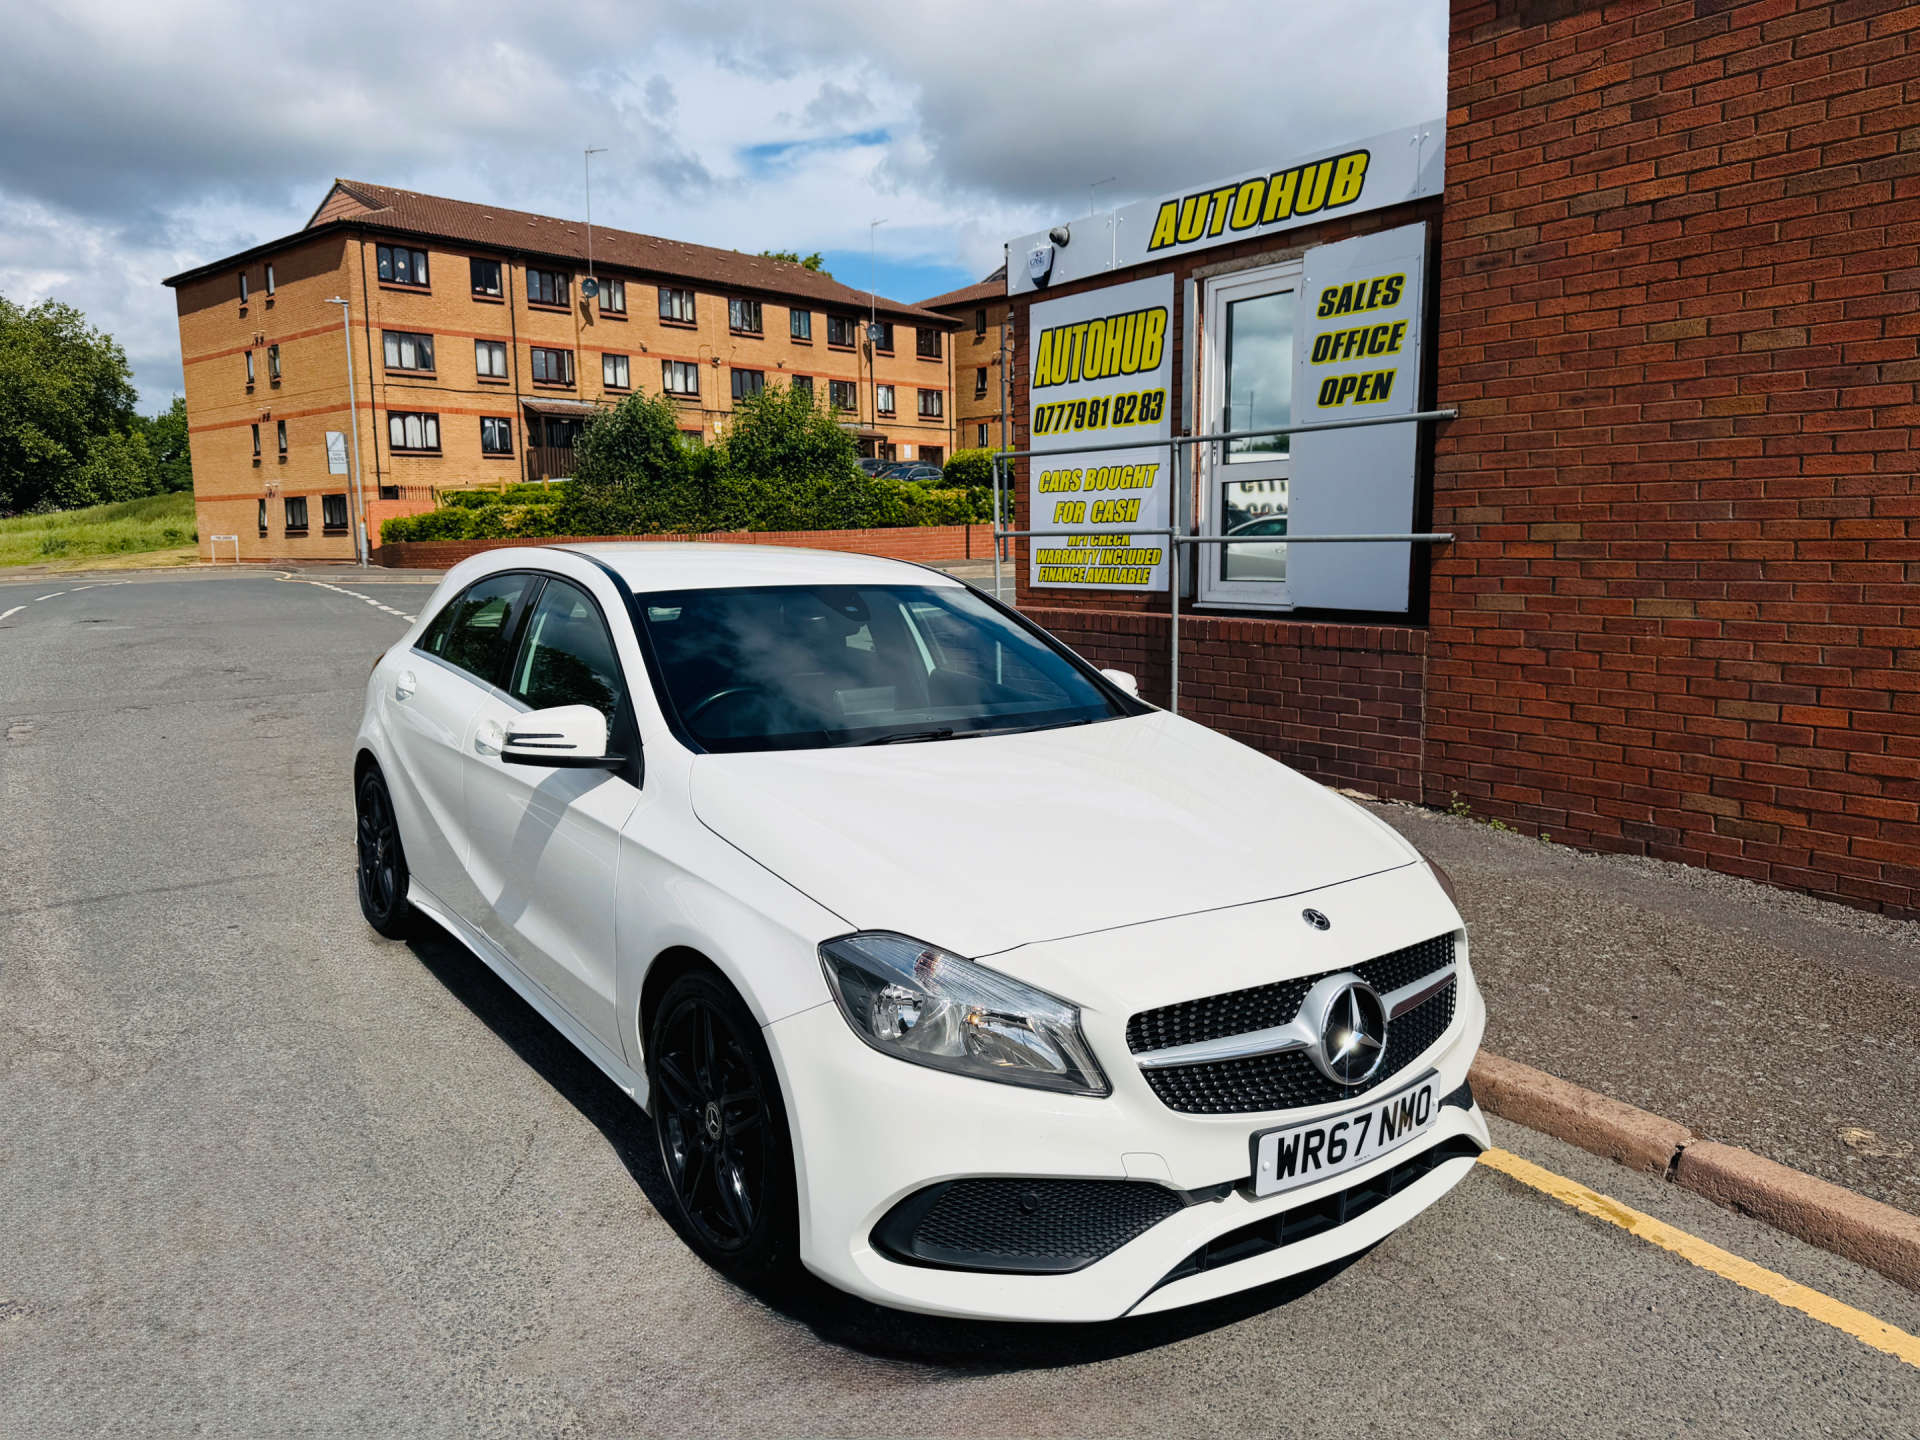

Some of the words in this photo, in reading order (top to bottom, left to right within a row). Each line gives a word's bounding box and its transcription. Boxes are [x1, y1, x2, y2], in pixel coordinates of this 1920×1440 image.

[1147, 149, 1371, 252] AUTOHUB
[1317, 273, 1406, 319] SALES
[1033, 306, 1168, 389] AUTOHUB
[1311, 319, 1408, 365] OFFICE
[1317, 368, 1397, 408] OPEN
[1039, 468, 1082, 493] CARS
[1083, 463, 1160, 491] BOUGHT
[1053, 501, 1086, 523] FOR
[1090, 498, 1141, 523] CASH
[1036, 548, 1100, 565] WARRANTY
[1099, 548, 1162, 565] INCLUDED
[1038, 566, 1086, 583] FINANCE
[1085, 567, 1151, 584] AVAILABLE
[1276, 1112, 1373, 1181] WR67
[1378, 1084, 1431, 1147] NMO
